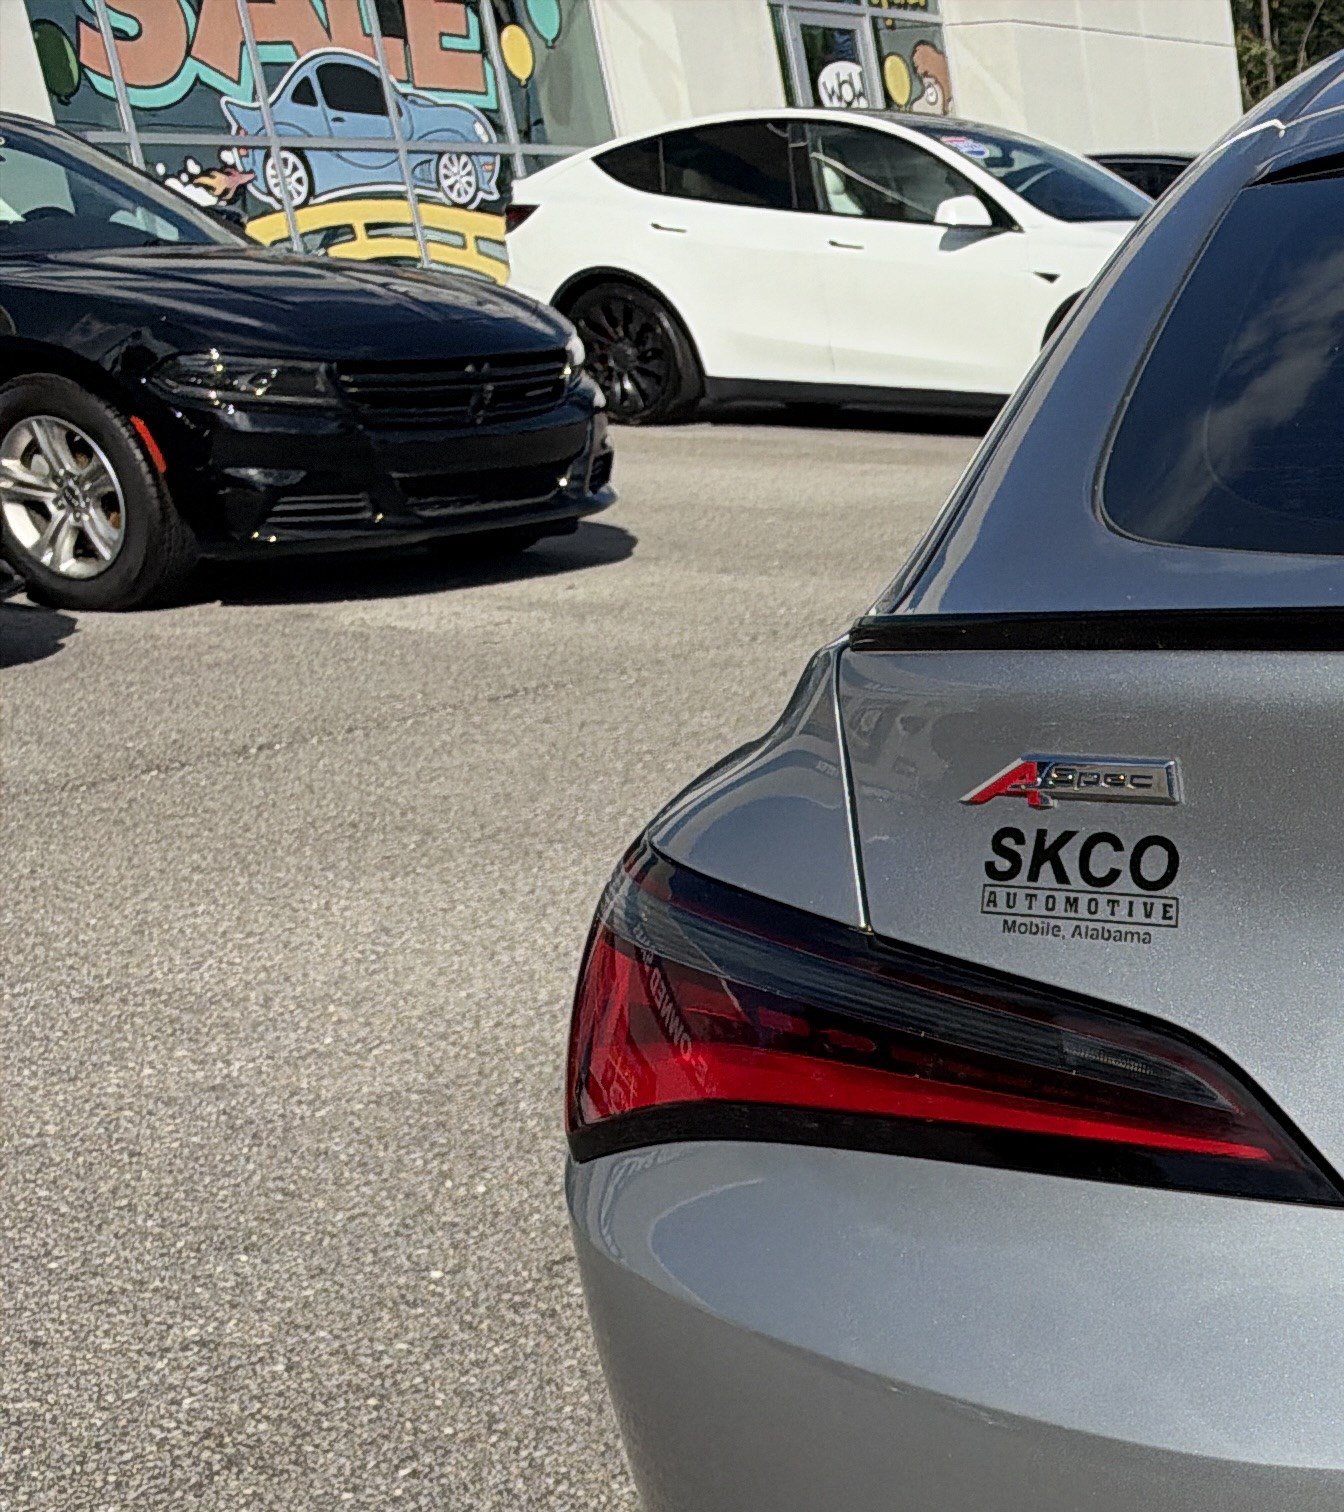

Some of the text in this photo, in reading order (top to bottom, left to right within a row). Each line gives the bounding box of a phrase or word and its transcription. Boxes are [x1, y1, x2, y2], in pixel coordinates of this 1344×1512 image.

[78, 0, 488, 94] SALE
[985, 826, 1180, 892] SKCO
[986, 891, 1175, 921] AUTOMOTIVE
[1002, 919, 1152, 944] Mobile, Alabama
